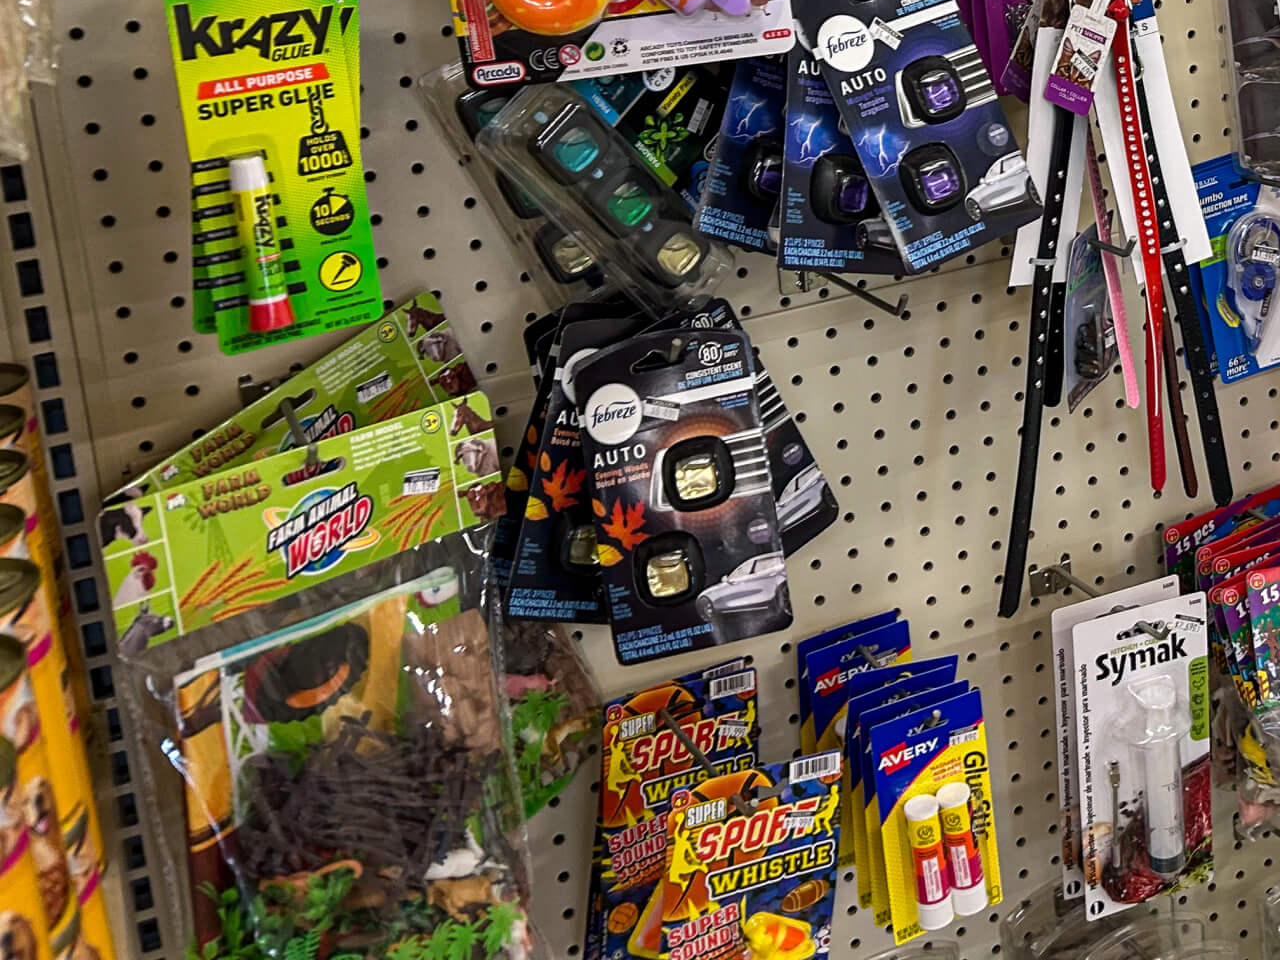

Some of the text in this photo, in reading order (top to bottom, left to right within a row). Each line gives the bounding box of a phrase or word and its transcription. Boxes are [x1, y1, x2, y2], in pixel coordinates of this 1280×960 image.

[1141, 23, 1149, 31] S
[272, 43, 312, 62] GLUE
[825, 30, 867, 60] febreze
[214, 66, 314, 96] ALL PURPOSE
[476, 65, 521, 82] Arcady
[839, 68, 888, 96] AUTO
[197, 82, 336, 121] SUPER GLUE
[306, 134, 338, 146] HOLDS
[311, 144, 335, 155] OVER
[299, 152, 344, 175] 1000
[313, 204, 329, 218] 10
[1231, 192, 1248, 207] TAPE
[314, 213, 350, 226] SECONDS
[702, 346, 718, 361] 80
[722, 360, 743, 372] SCENT
[591, 399, 638, 429] febreze
[593, 443, 647, 470] AUTO
[201, 471, 262, 501] FARM
[199, 484, 273, 520] WORLD
[267, 483, 358, 551] FARM ANIMAL
[287, 496, 375, 578] WORLD
[1174, 518, 1216, 556] 15 pcs
[1260, 585, 1280, 605] 15
[1094, 632, 1188, 688] Symak
[620, 713, 655, 738] SUPER
[877, 737, 939, 772] AVERY
[686, 799, 726, 827] SUPER
[695, 796, 821, 863] SPORT
[709, 843, 833, 896] WHISTLE
[667, 903, 740, 948] SUPER
